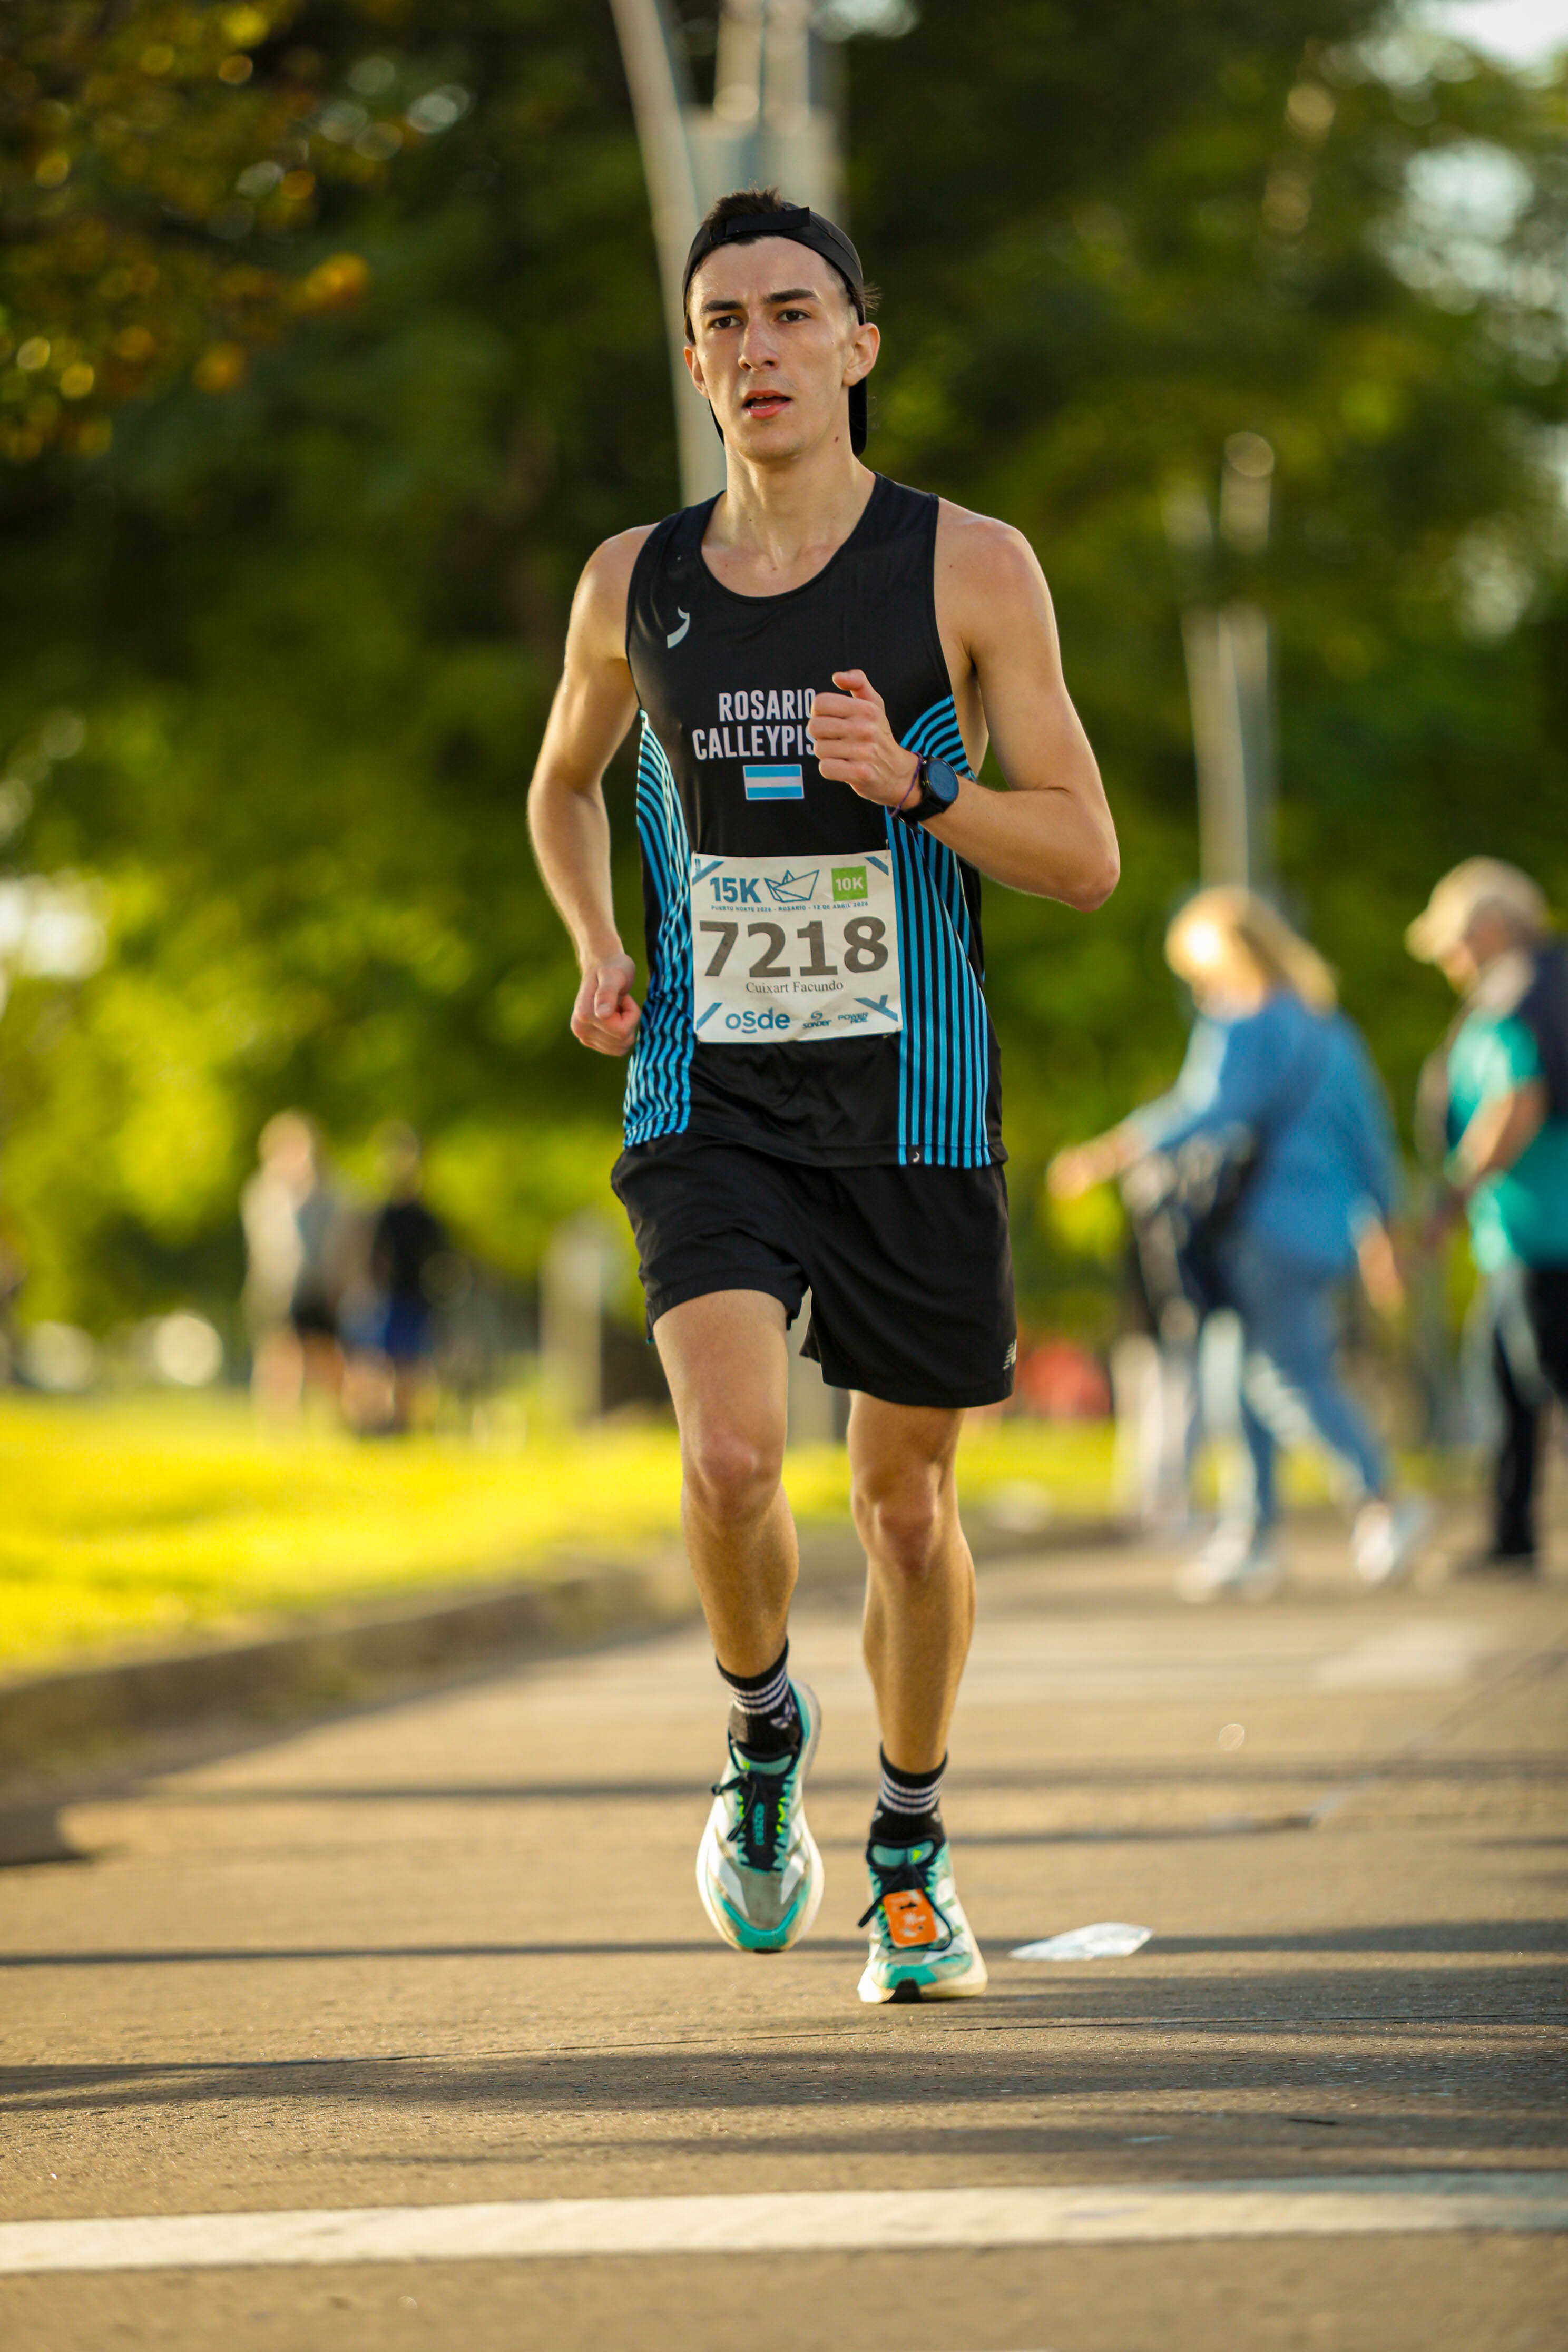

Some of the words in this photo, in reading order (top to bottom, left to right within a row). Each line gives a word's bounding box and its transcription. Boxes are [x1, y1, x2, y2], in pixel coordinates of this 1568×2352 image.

[719, 688, 816, 722] ROSARIO
[710, 877, 762, 903] 15K
[836, 876, 864, 891] 10K
[700, 916, 888, 977] 7218
[746, 982, 788, 993] Cuixart
[792, 980, 843, 992] Facundo
[726, 1007, 790, 1030] osde
